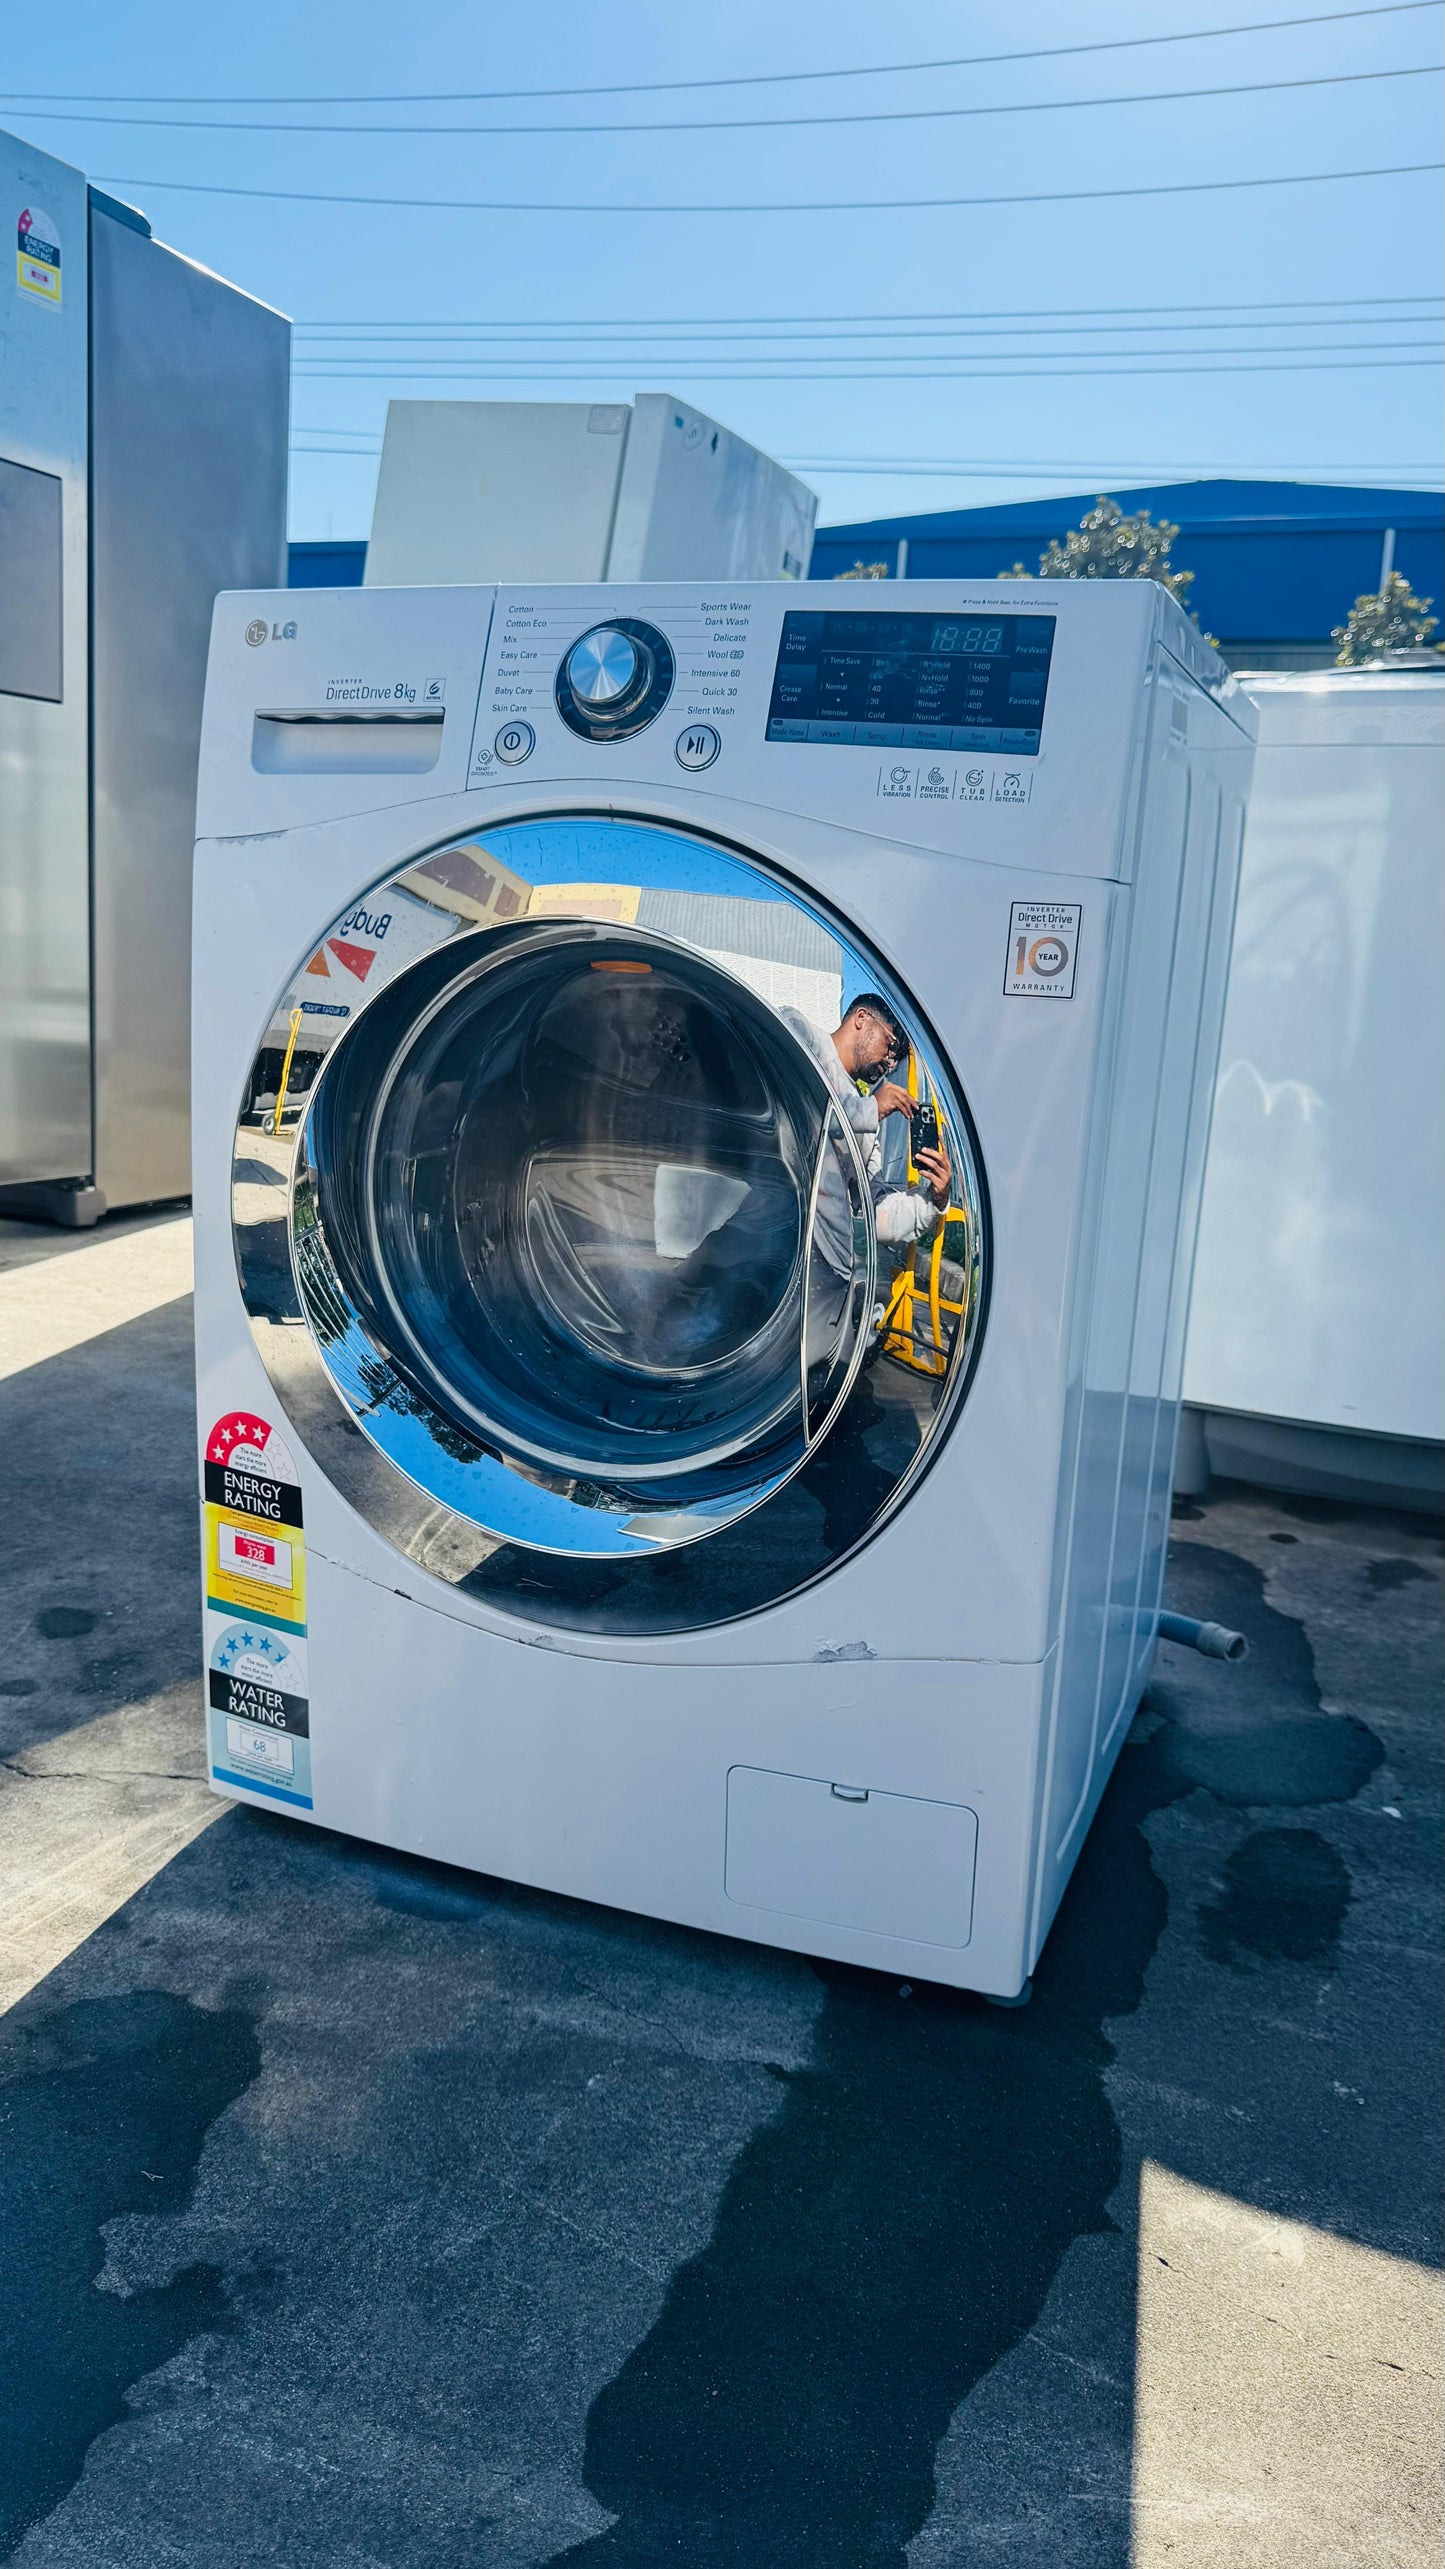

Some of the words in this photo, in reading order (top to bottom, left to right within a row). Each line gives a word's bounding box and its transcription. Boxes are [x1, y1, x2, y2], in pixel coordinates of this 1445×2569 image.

[700, 603, 728, 612] Sports
[729, 603, 751, 611] Wear
[726, 618, 749, 626] Wash
[271, 621, 298, 640] LG
[713, 633, 746, 642] Delicate
[789, 634, 806, 642] Time
[786, 643, 807, 651] Delay
[500, 652, 518, 660] Easy
[707, 650, 728, 659] Wool
[691, 669, 728, 677] Intensive
[730, 670, 740, 678] 60
[495, 687, 513, 696] Baby
[780, 685, 802, 693] Crease
[825, 683, 848, 691] Normal
[394, 683, 416, 702] 8kg
[702, 688, 725, 696] Quick
[727, 688, 737, 696] 30
[1009, 697, 1040, 706] Favorite
[492, 704, 508, 712] Skin
[687, 706, 710, 715] Silent
[712, 707, 735, 716] Wash
[822, 709, 848, 717] Intensive
[977, 716, 993, 724] Spin
[821, 730, 840, 738] Wash
[970, 733, 986, 741] Spin
[1018, 913, 1046, 922] Direct
[1048, 914, 1072, 923] Drive
[1016, 936, 1069, 977] 10
[1038, 953, 1059, 961] YEAR
[1013, 983, 1065, 992] WARRANTY
[224, 1471, 281, 1500] ENERGY
[225, 1489, 281, 1519] RATING
[247, 1546, 265, 1561] 328
[230, 1679, 284, 1710] WATER
[229, 1696, 286, 1727] RATING
[254, 1740, 266, 1752] 68
